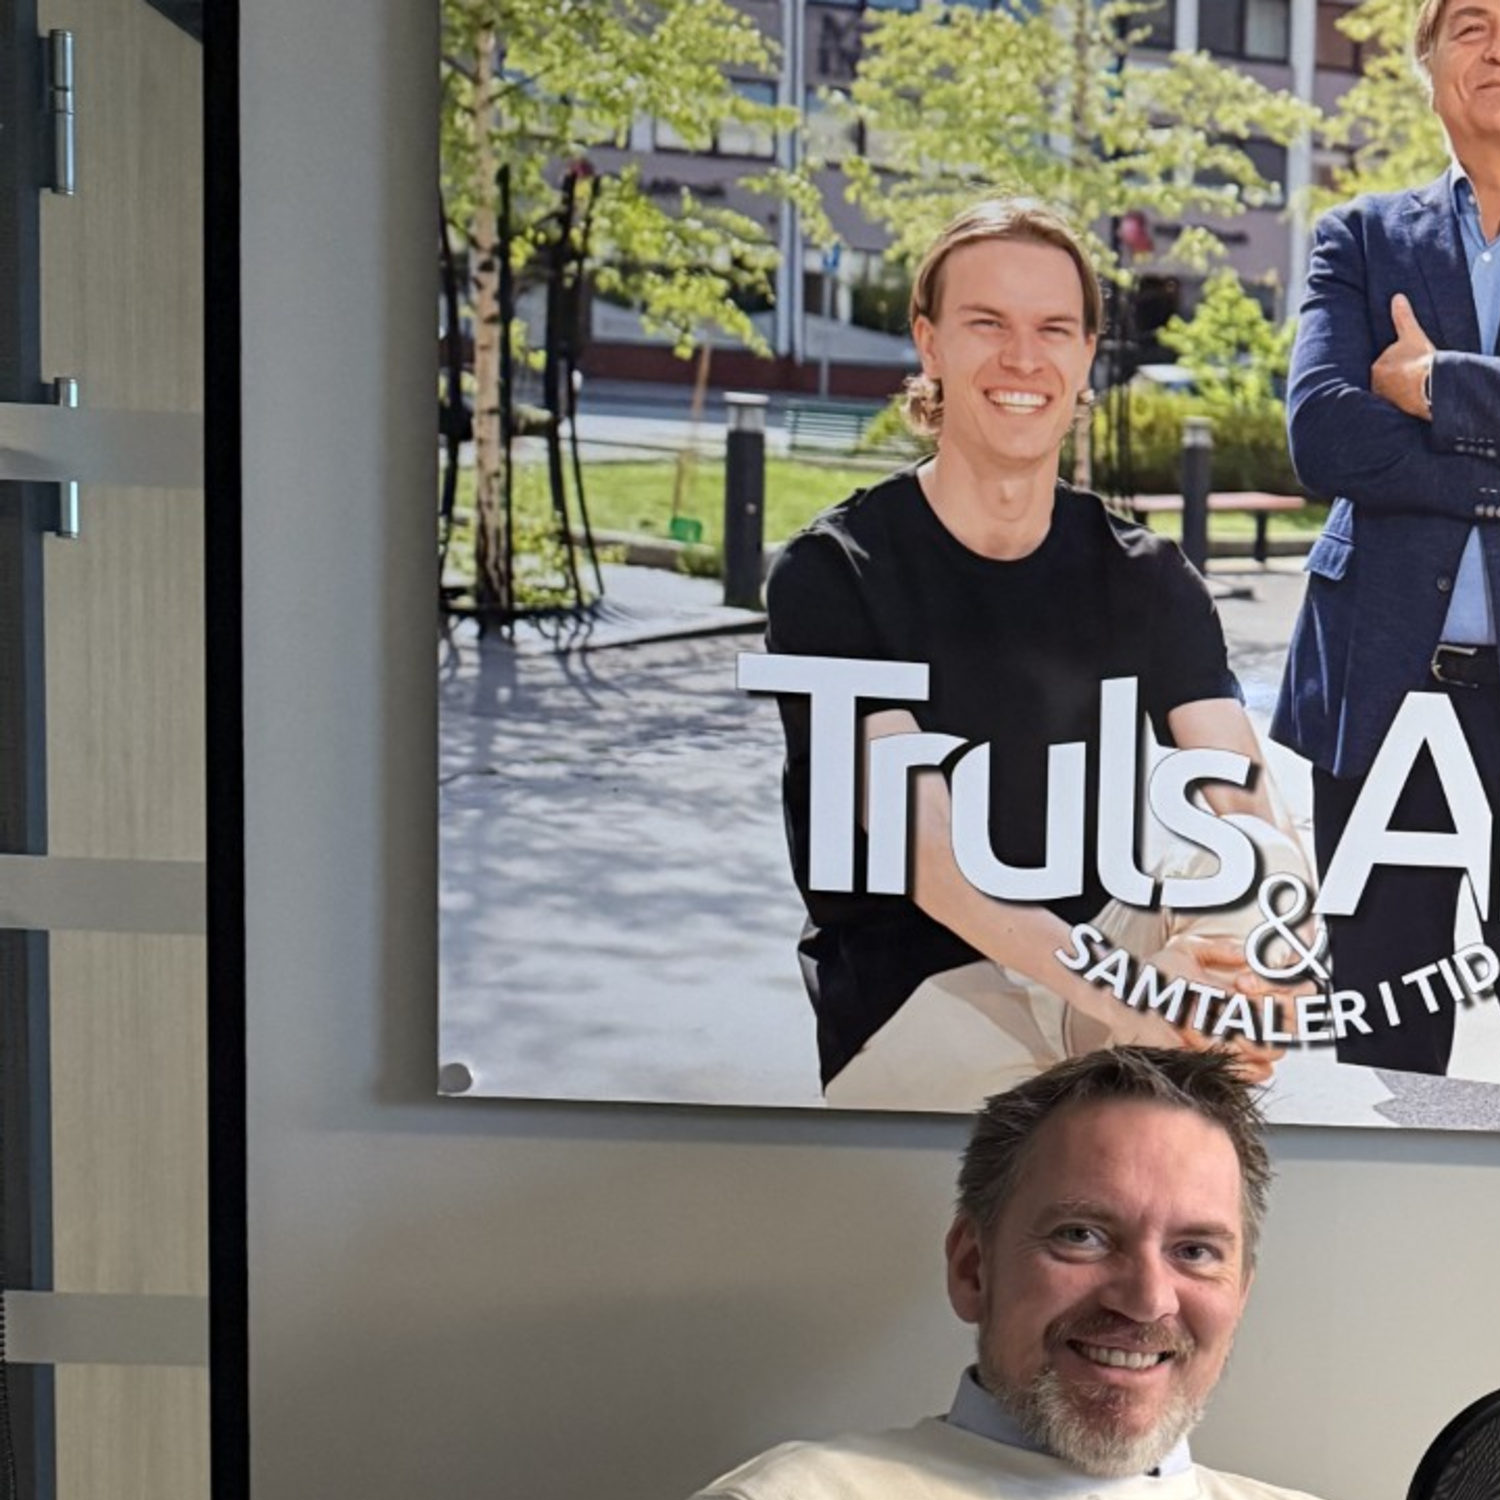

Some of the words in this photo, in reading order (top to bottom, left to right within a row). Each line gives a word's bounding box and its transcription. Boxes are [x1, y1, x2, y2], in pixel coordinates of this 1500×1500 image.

[735, 652, 1258, 908] Truls
[1244, 872, 1330, 981] &
[1054, 922, 1374, 1042] SAMTALER
[1378, 980, 1401, 1027] I
[1401, 941, 1500, 1015] TID
